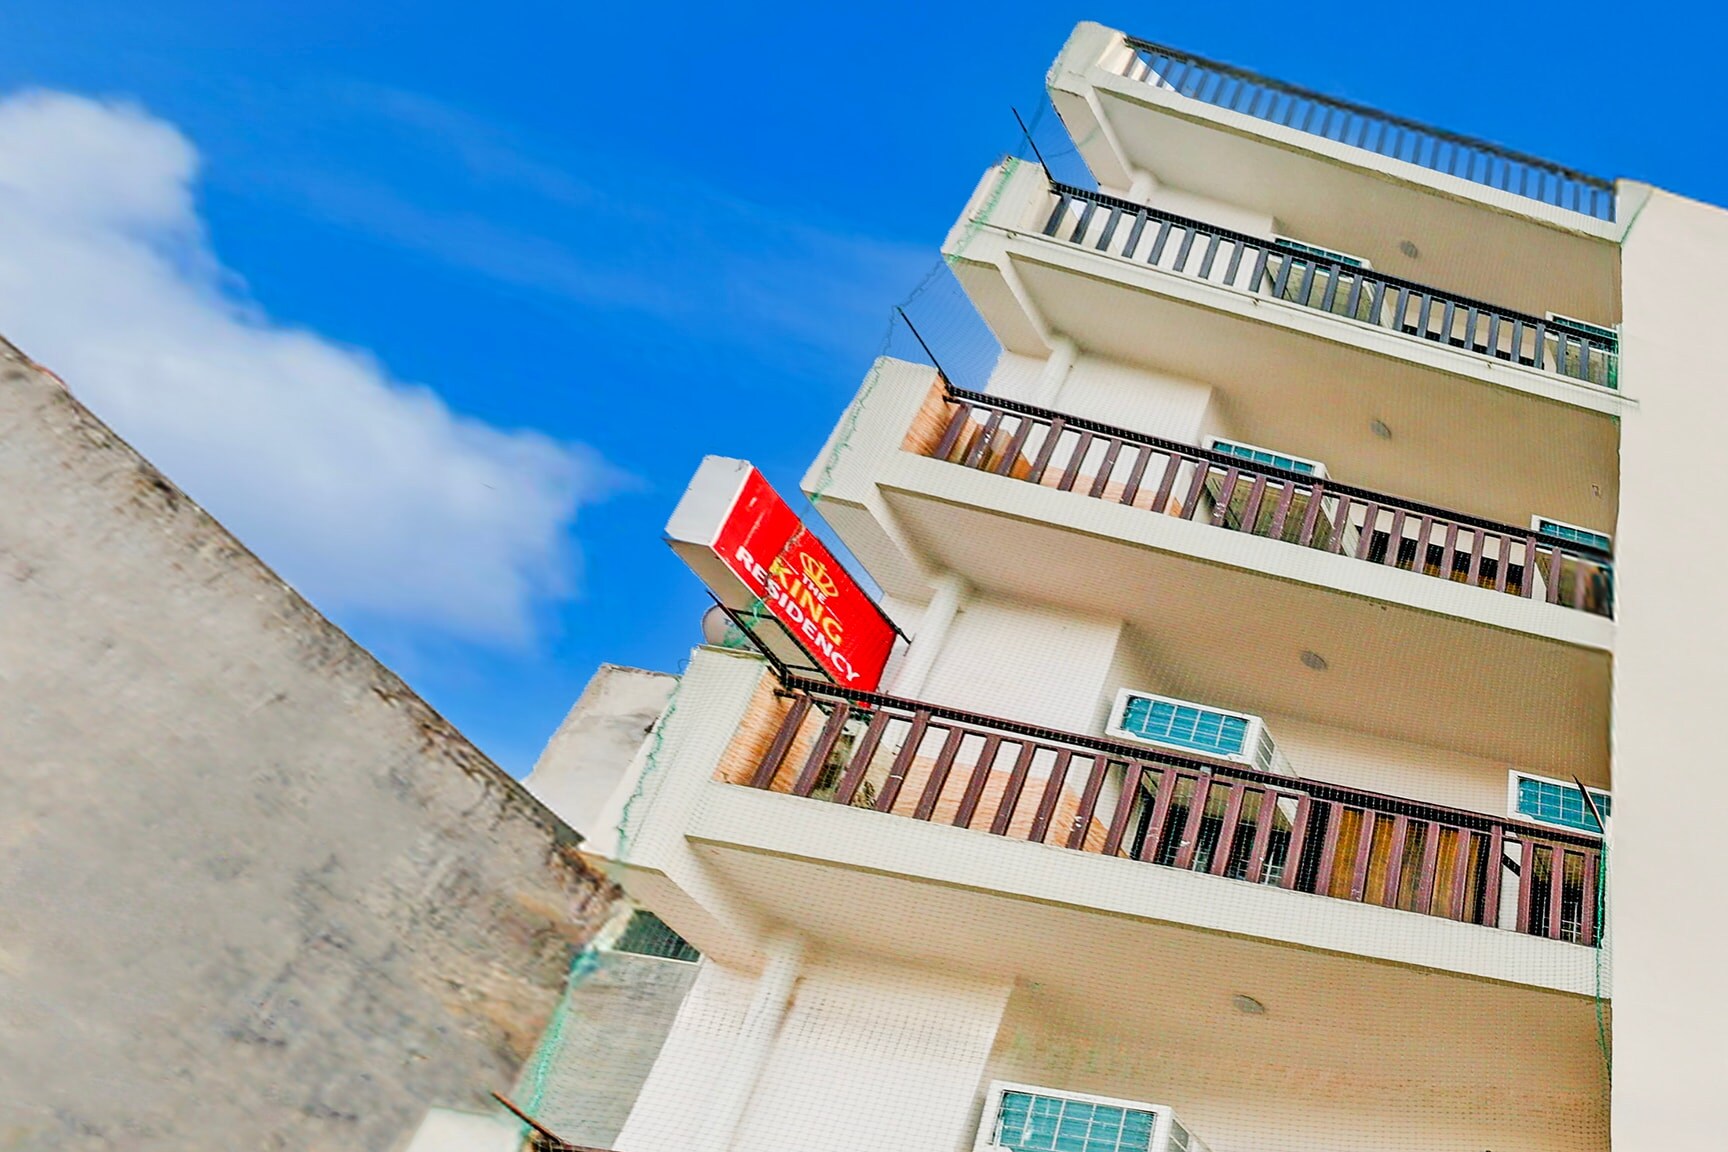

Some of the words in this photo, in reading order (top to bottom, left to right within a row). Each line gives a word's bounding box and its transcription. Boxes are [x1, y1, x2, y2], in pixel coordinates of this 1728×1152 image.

[735, 545, 860, 682] RESIDENCY
[768, 556, 844, 646] KING
[801, 572, 828, 605] THE
